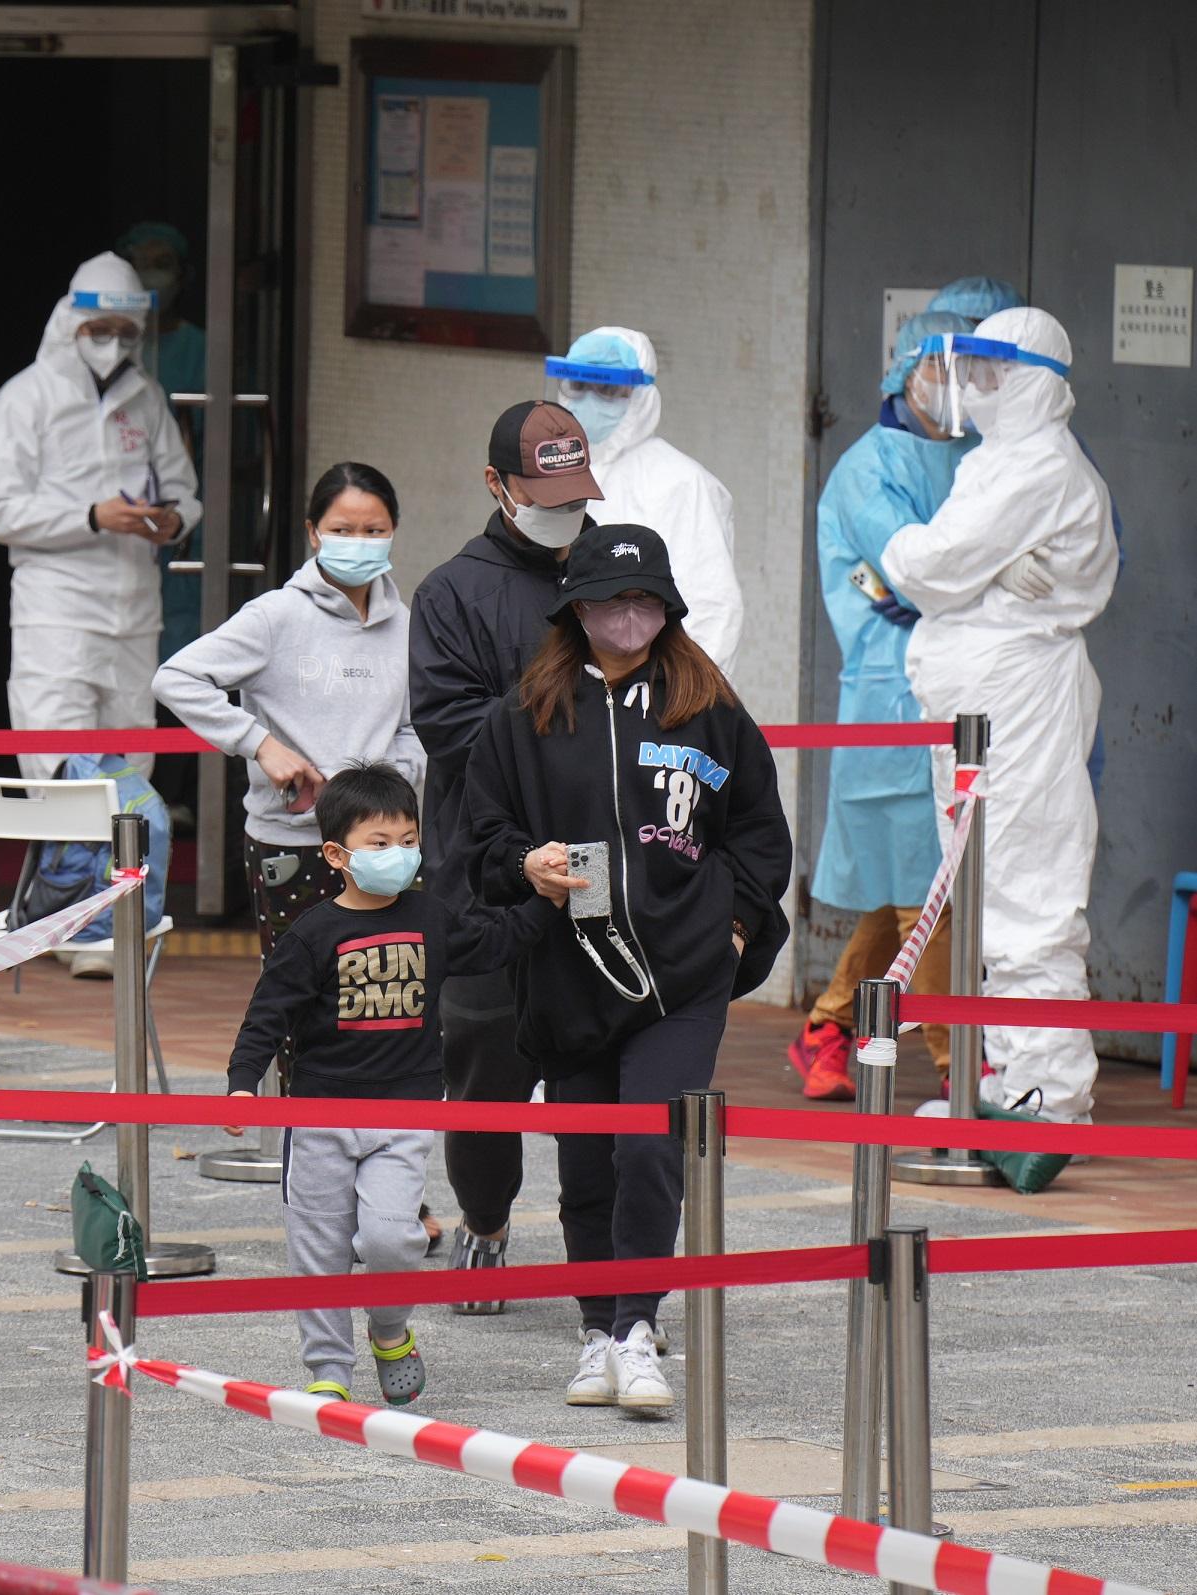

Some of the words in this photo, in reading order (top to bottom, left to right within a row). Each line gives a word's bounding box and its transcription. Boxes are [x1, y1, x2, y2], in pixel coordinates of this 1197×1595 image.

[539, 449, 585, 465] INDEPENDENT
[342, 668, 374, 679] SEOUL
[337, 943, 426, 987] RUN
[337, 980, 426, 1019] DMC
